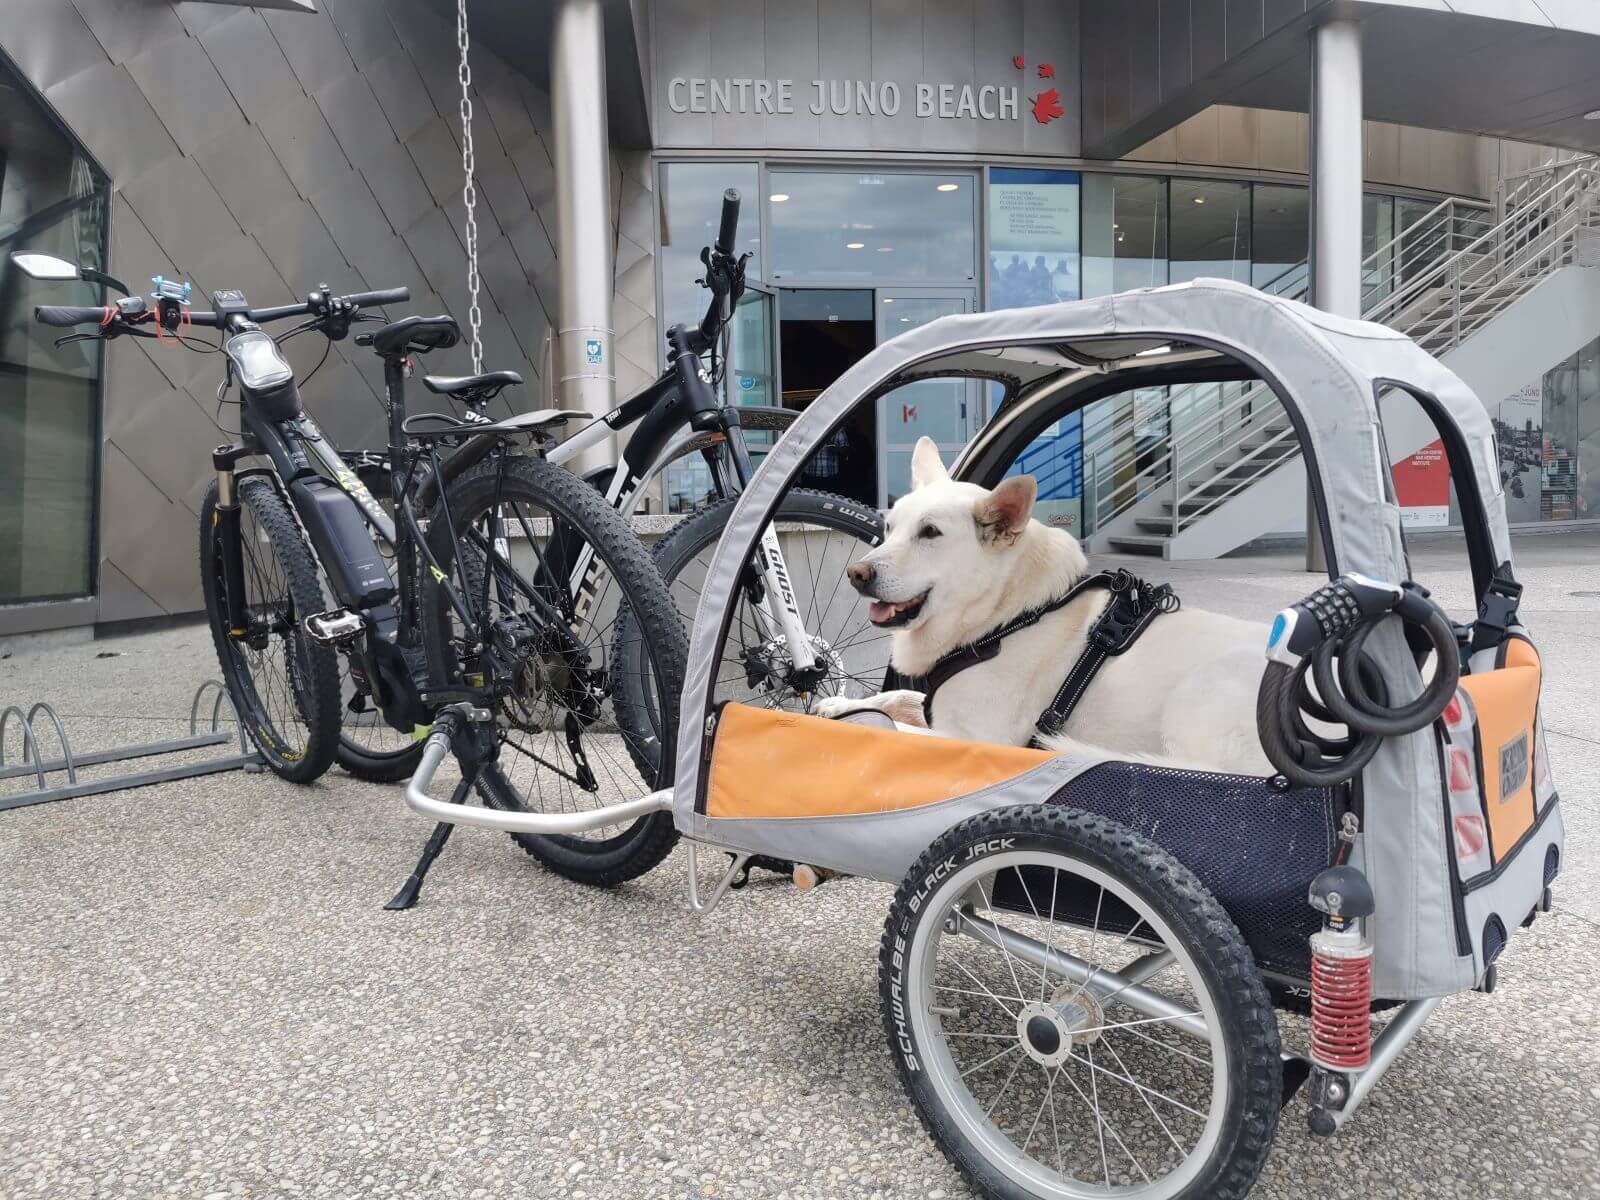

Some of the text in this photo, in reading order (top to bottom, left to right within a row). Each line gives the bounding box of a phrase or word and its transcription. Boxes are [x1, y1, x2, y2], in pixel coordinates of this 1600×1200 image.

[668, 77, 1019, 121] CENTRE JUNO BEACH
[839, 507, 878, 527] TOM
[768, 547, 799, 618] GHOST
[890, 837, 1016, 1072] SCHWALBE BLACK JACK
